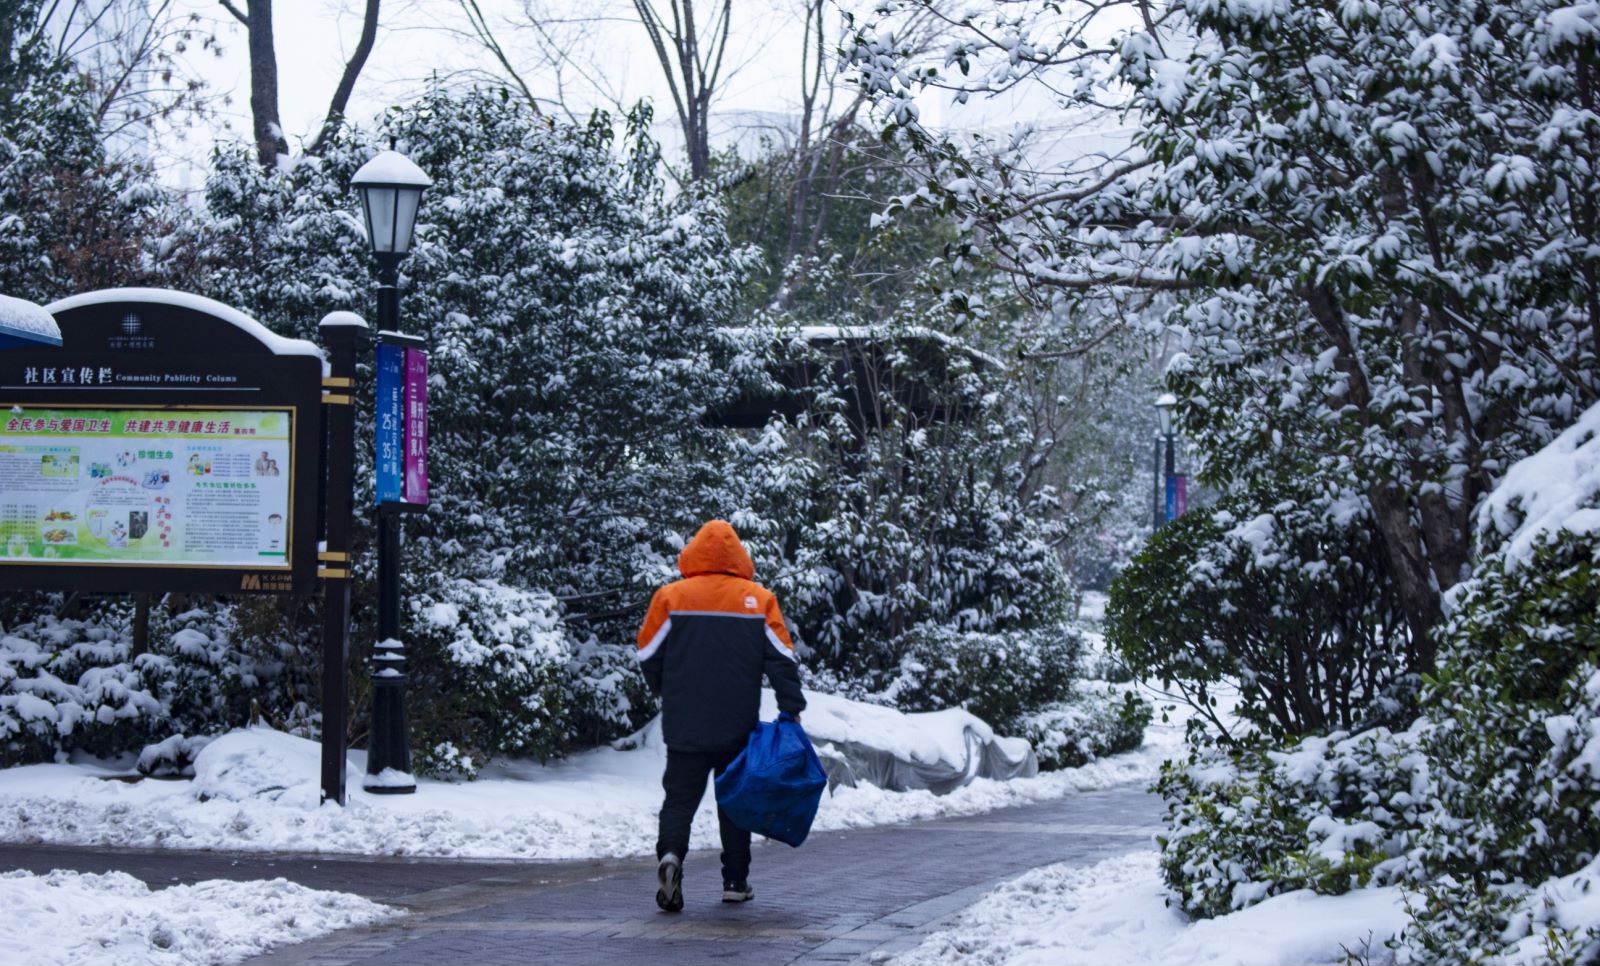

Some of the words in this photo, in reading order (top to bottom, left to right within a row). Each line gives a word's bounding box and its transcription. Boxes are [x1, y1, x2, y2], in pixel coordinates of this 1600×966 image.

[24, 367, 112, 384] 社区宣传栏
[115, 374, 161, 383] Community
[164, 374, 201, 383] Publicity
[206, 374, 237, 383] Column
[6, 418, 111, 433] 全民参与爱国卫生
[124, 419, 231, 434] 共建共享健康生活
